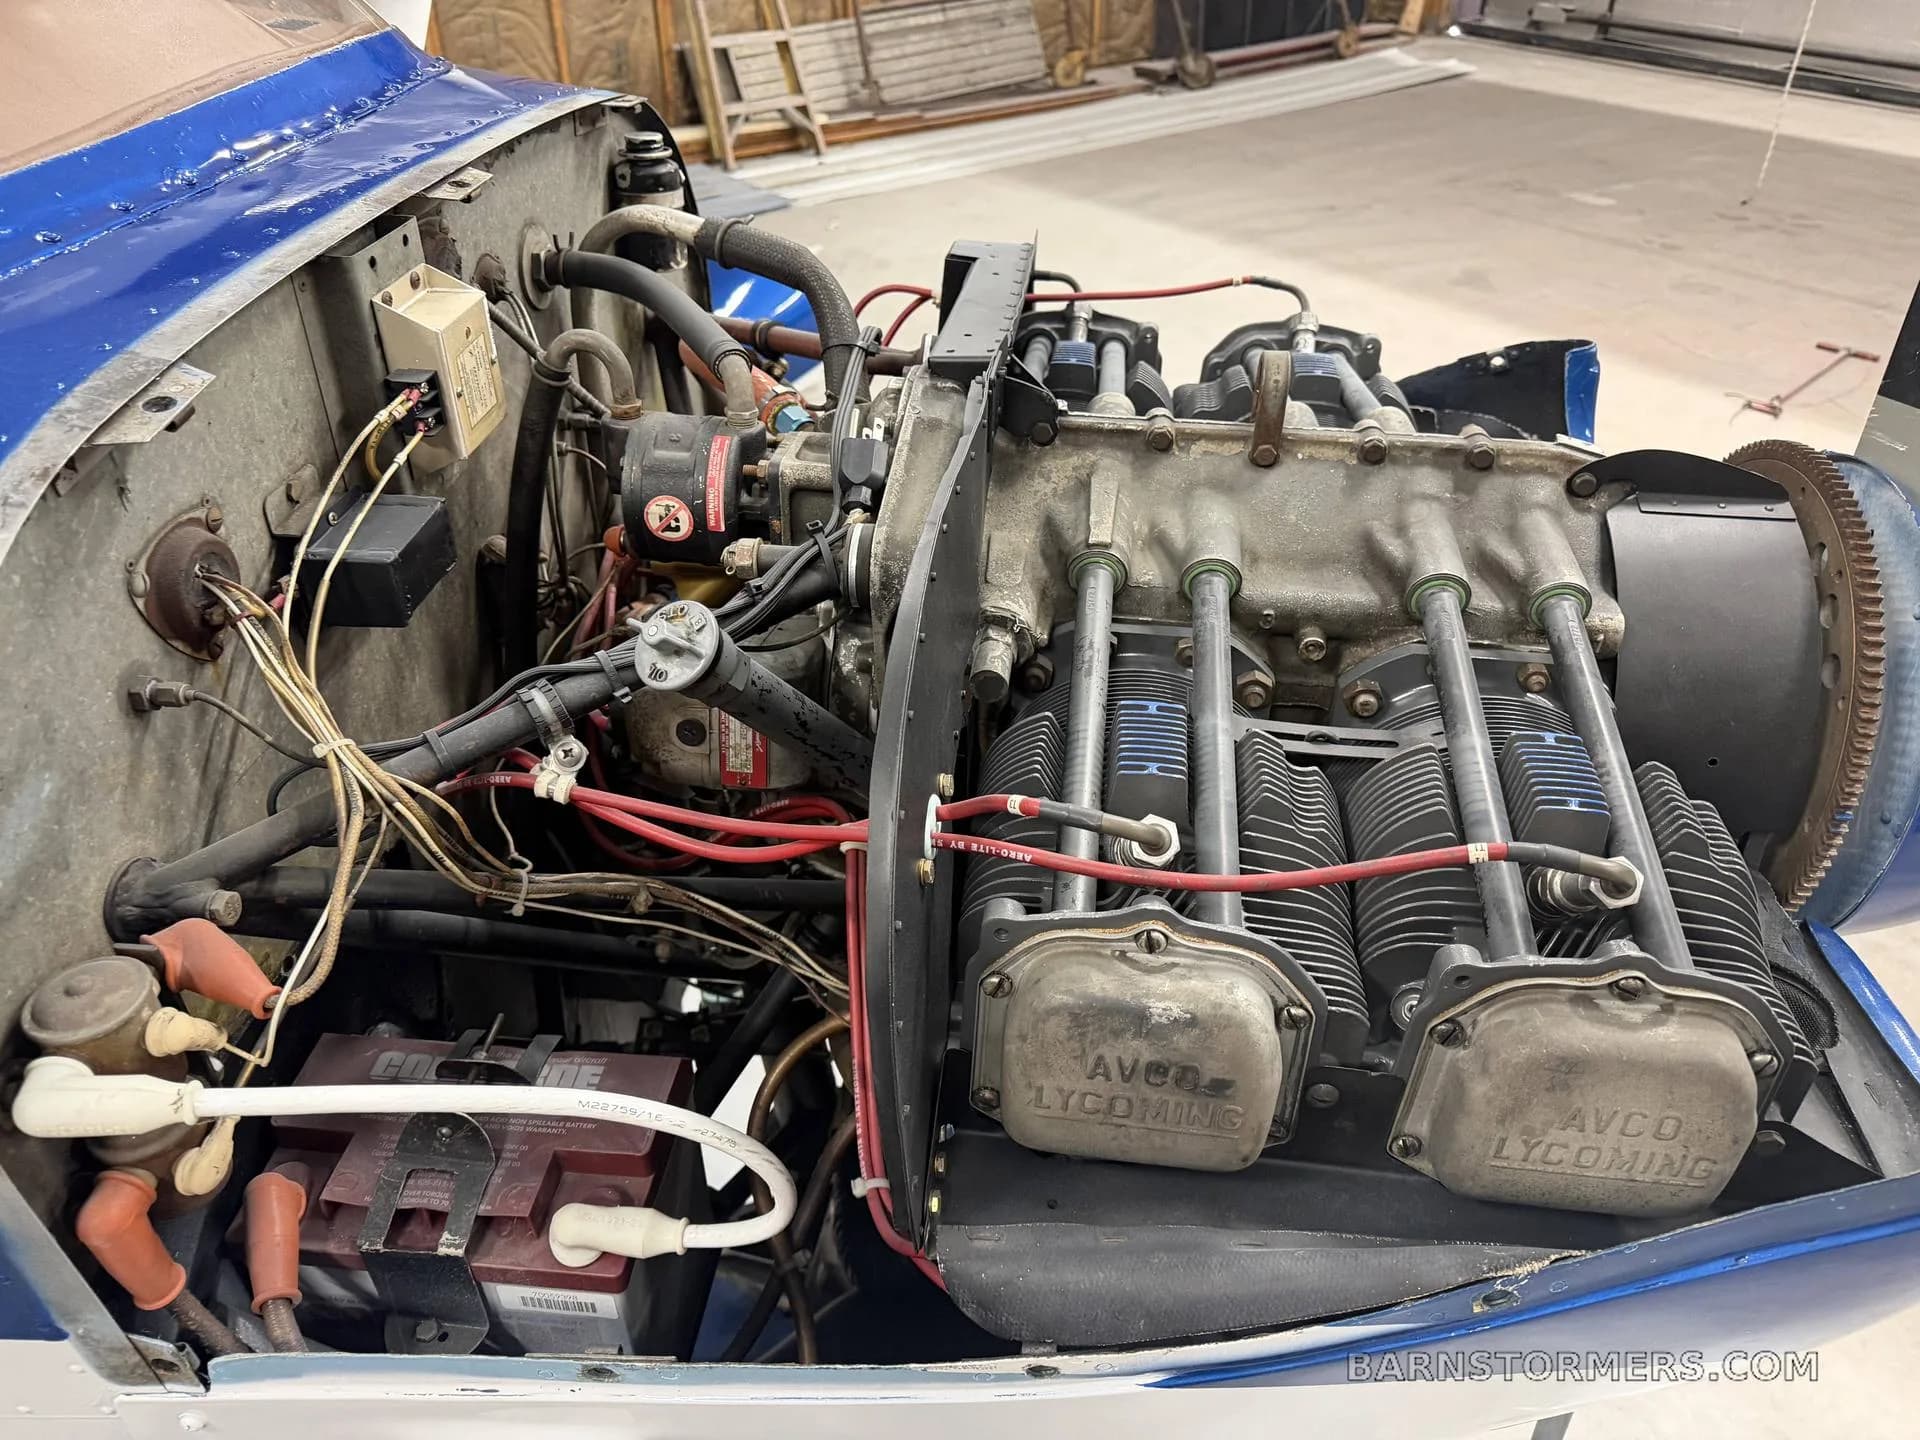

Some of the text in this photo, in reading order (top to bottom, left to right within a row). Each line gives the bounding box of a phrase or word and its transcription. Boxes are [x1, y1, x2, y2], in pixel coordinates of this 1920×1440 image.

[647, 661, 668, 682] OIL
[949, 840, 965, 850] BY
[970, 843, 1033, 863] AERO-LITE
[1085, 1052, 1200, 1091] AVCO
[1033, 1082, 1245, 1131] LYCOMING
[509, 1118, 527, 1126] NON
[528, 1119, 565, 1128] SPILLABLE
[565, 1121, 599, 1130] BATTERY
[1561, 1108, 1683, 1140] AVCO
[1489, 1134, 1719, 1181] LYCOMING
